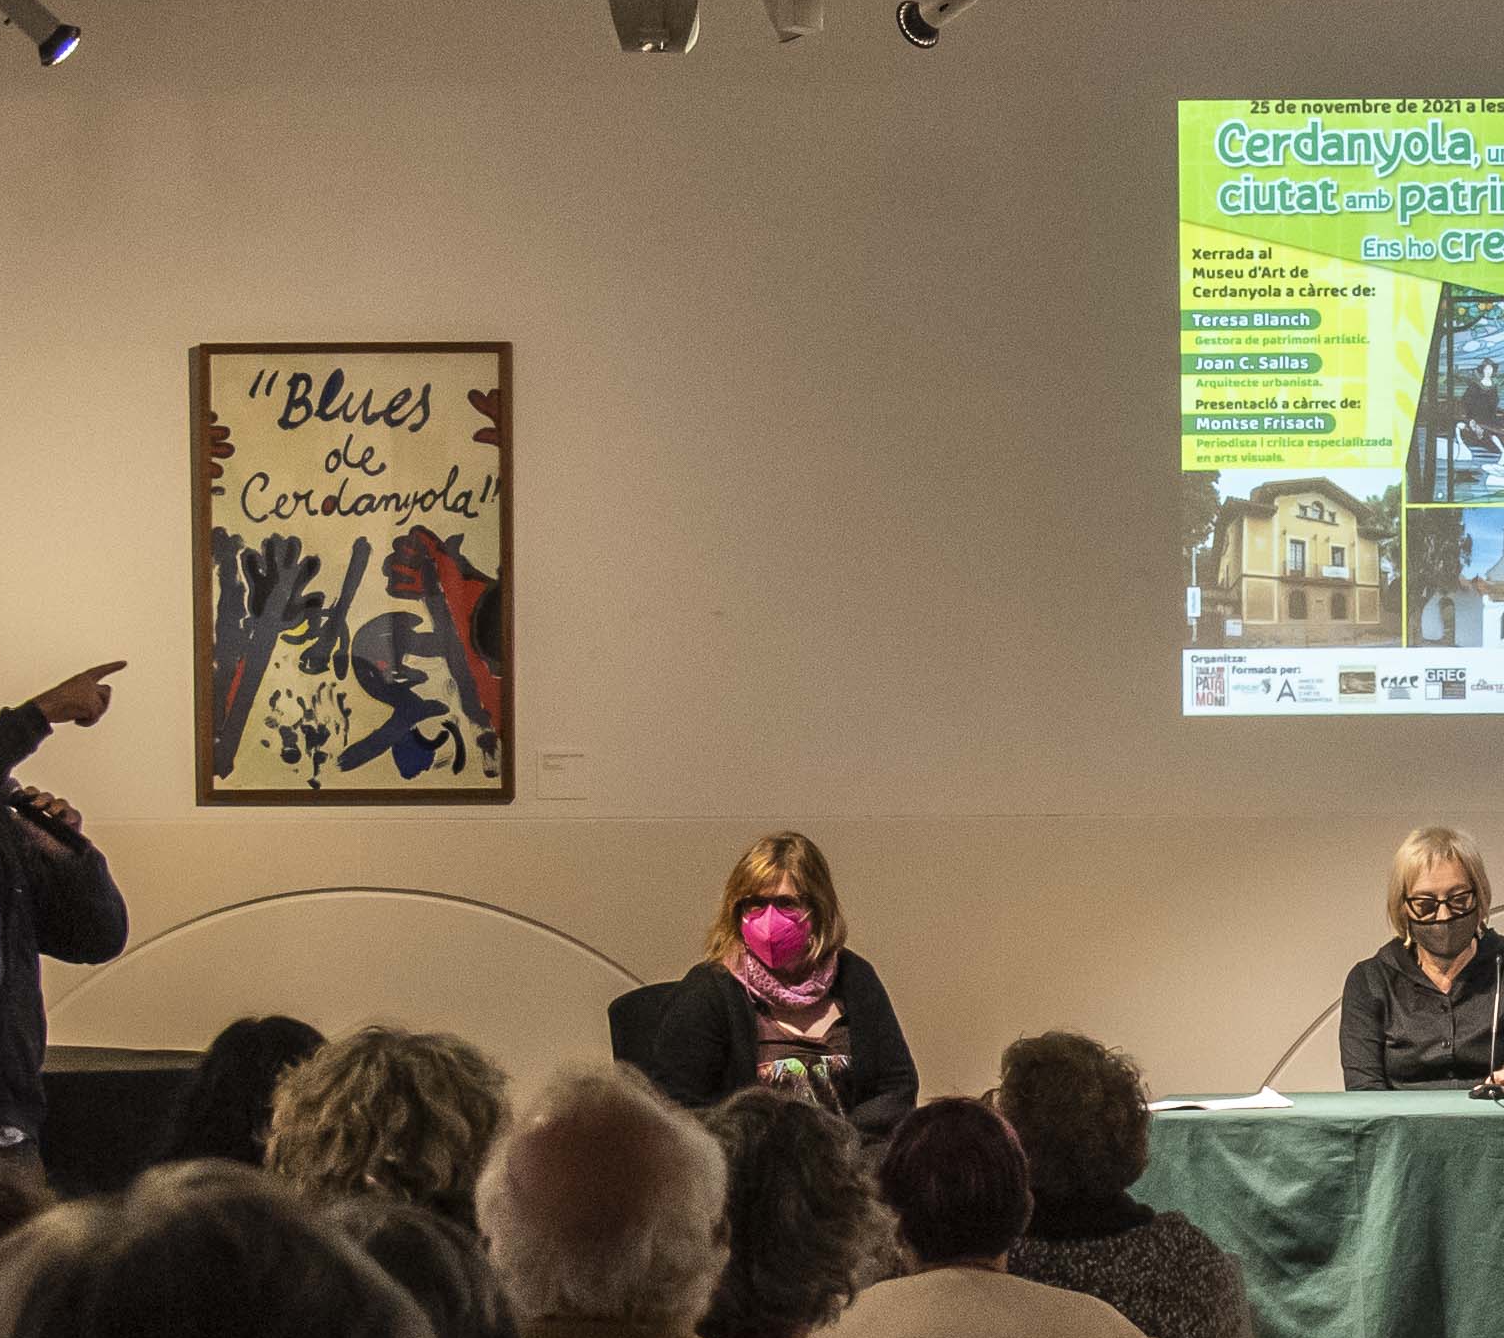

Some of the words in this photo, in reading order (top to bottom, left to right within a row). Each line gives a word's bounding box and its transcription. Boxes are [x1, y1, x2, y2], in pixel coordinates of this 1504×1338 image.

[1250, 99, 1270, 114] 25
[1275, 99, 1296, 114] de
[1301, 99, 1391, 114] novembre
[1396, 99, 1417, 114] de
[1422, 99, 1461, 114] 2021
[1466, 103, 1477, 113] a
[1481, 99, 1504, 113] les
[1217, 118, 1480, 175] Cerdanyola,
[1218, 176, 1338, 214] ciutat
[1345, 189, 1391, 211] amb
[1192, 248, 1254, 260] Xerrada
[1259, 247, 1272, 260] al
[1363, 237, 1401, 257] Ens
[1407, 236, 1435, 257] ho
[1193, 267, 1244, 279] Museu
[1248, 266, 1285, 279] d'Art
[1290, 266, 1309, 278] de
[1193, 285, 1281, 300] Cerdanyola
[1286, 287, 1294, 297] a
[1299, 283, 1347, 298] càrrec
[1352, 284, 1376, 297] de:
[1192, 313, 1248, 326] Teresa
[1253, 312, 1310, 326] Blanch
[1195, 335, 1242, 346] Gestora
[1245, 335, 1259, 345] de
[1262, 334, 1321, 349] patrimoni
[1196, 357, 1234, 370] Joan
[1240, 356, 1254, 370] C.
[1259, 356, 1309, 370] Sallas
[1196, 378, 1259, 389] Arquitecte
[1196, 397, 1278, 410] Presentació
[1282, 400, 1290, 409] a
[1293, 397, 1336, 409] càrrec
[1340, 397, 1361, 409] de:
[1196, 417, 1258, 430] Montse
[1263, 416, 1325, 429] Frisach
[1197, 437, 1257, 448] Periodista
[324, 433, 387, 476] de
[1191, 654, 1246, 664] Organitza:
[1231, 665, 1277, 675] formada
[1280, 666, 1301, 677] per:
[1425, 669, 1466, 681] GREC
